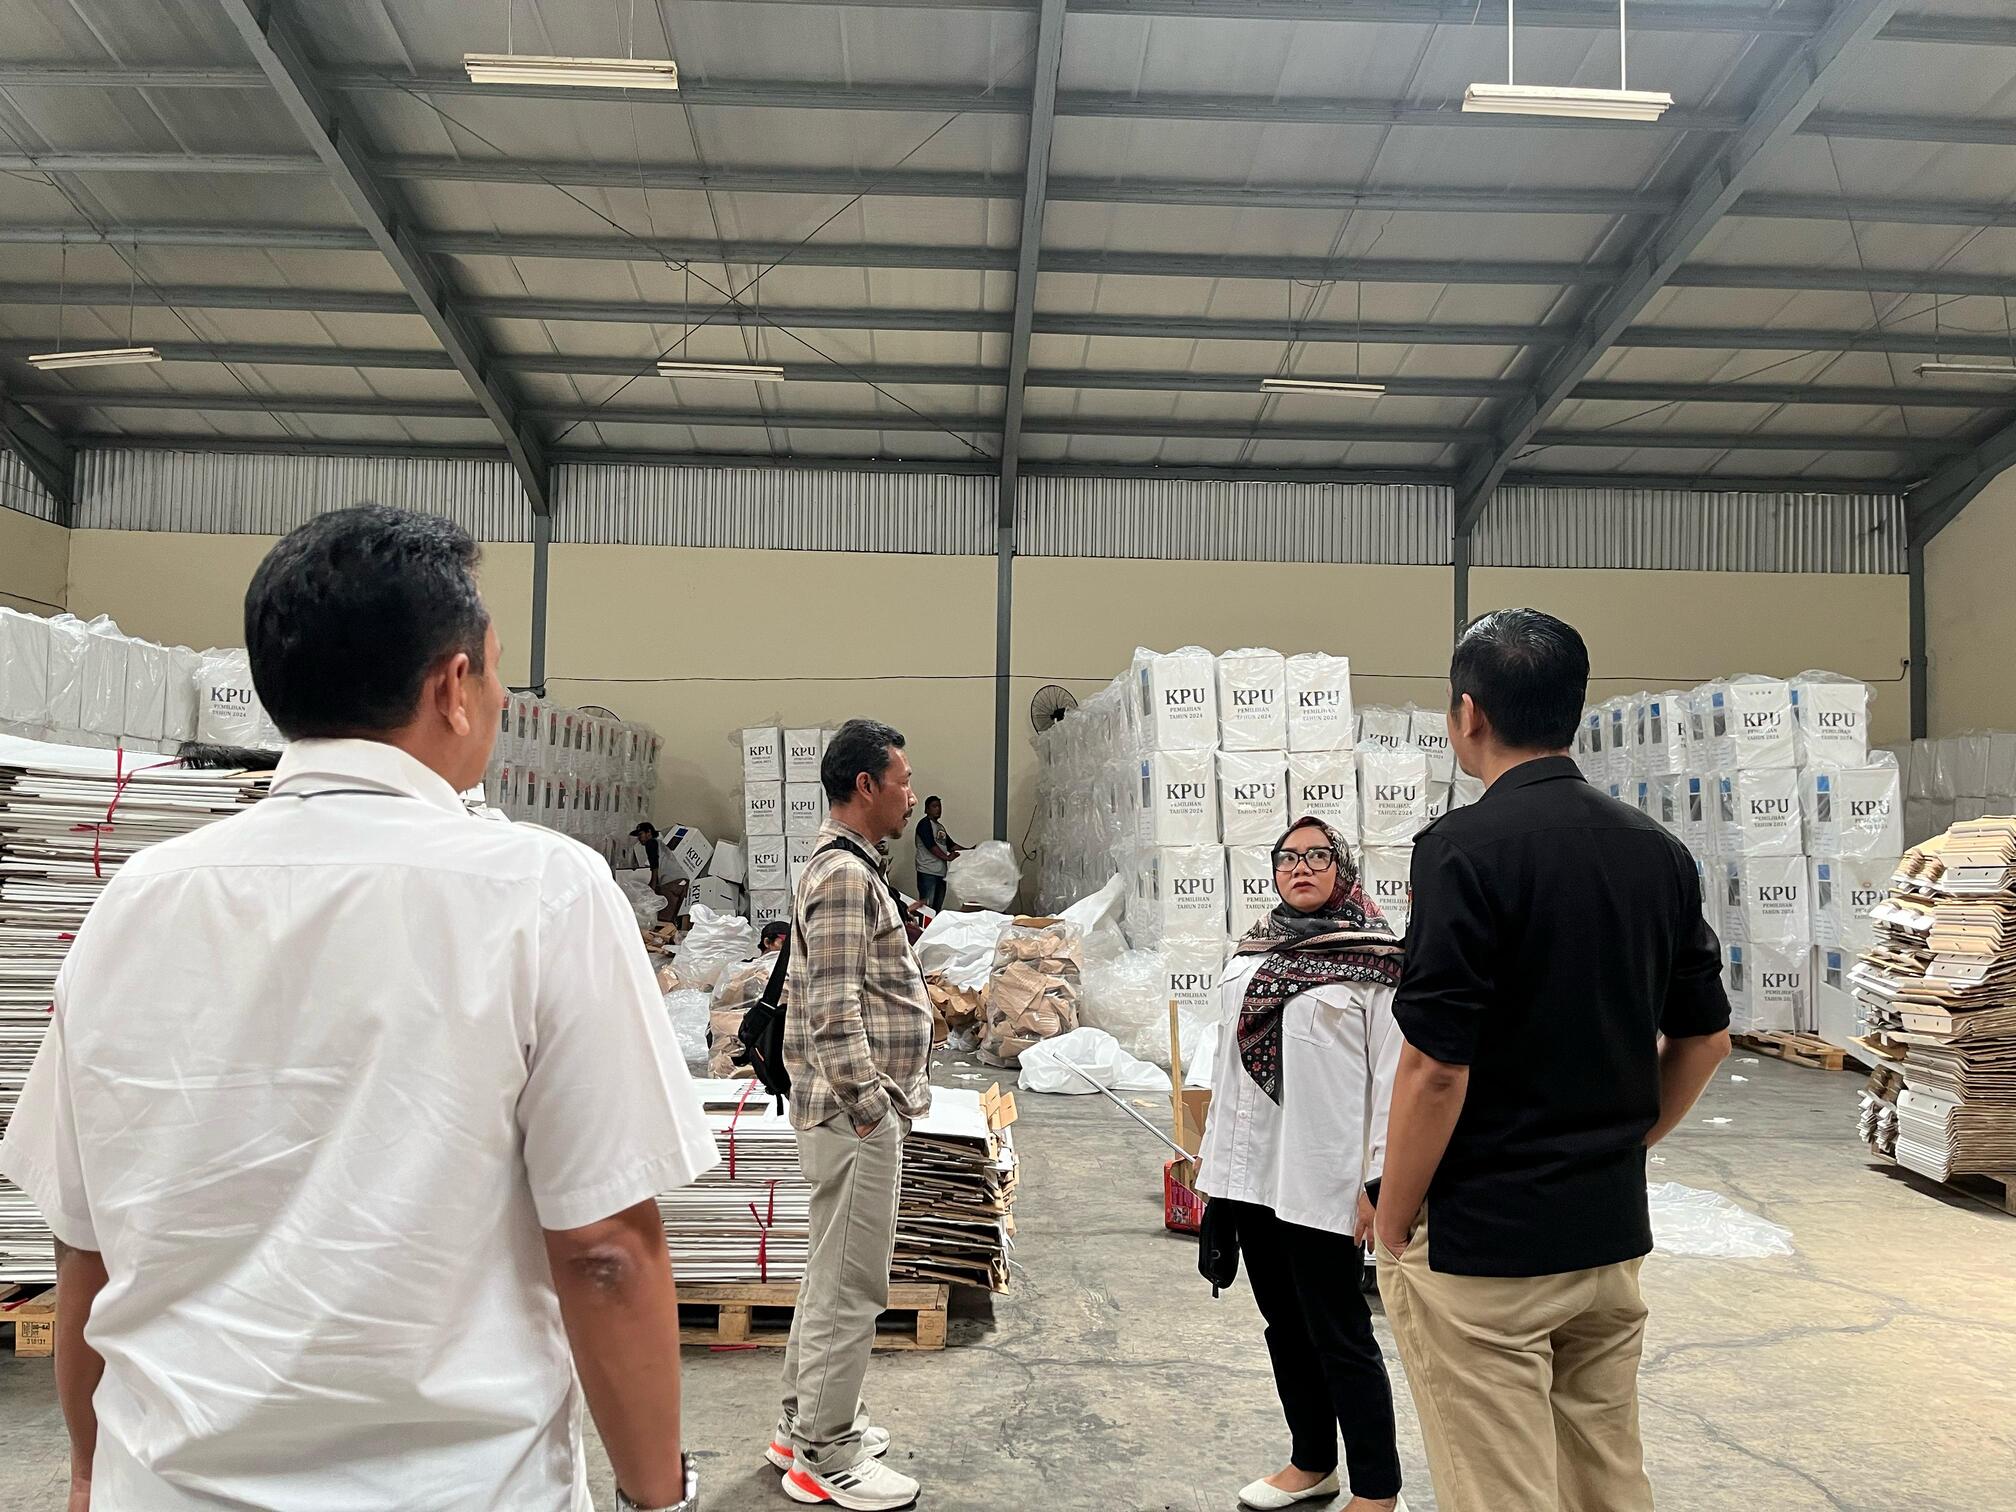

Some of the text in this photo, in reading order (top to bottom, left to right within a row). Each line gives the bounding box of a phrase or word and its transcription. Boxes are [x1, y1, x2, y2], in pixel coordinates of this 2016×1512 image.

[211, 687, 251, 704] KPU
[1165, 688, 1205, 705] KPU
[1233, 689, 1274, 705] KPU
[1299, 690, 1340, 707] KPU
[1743, 712, 1781, 727] KPU
[1818, 712, 1856, 727] KPU
[1418, 734, 1448, 749] KPU
[749, 745, 773, 756] KPU
[791, 746, 816, 757] KPU
[1166, 783, 1206, 800] KPU
[1234, 783, 1276, 800] KPU
[1303, 784, 1344, 800] KPU
[1375, 785, 1416, 801] KPU
[751, 800, 775, 809] KPU
[791, 801, 815, 811] KPU
[1751, 799, 1789, 814] KPU
[1851, 800, 1890, 816] KPU
[686, 846, 703, 867] KPU
[754, 854, 779, 864] KPU
[793, 855, 809, 863] KP
[1173, 878, 1215, 895] KPU
[1758, 886, 1797, 901] KPU
[1171, 974, 1212, 990] KPU
[1762, 973, 1800, 988] KPU
